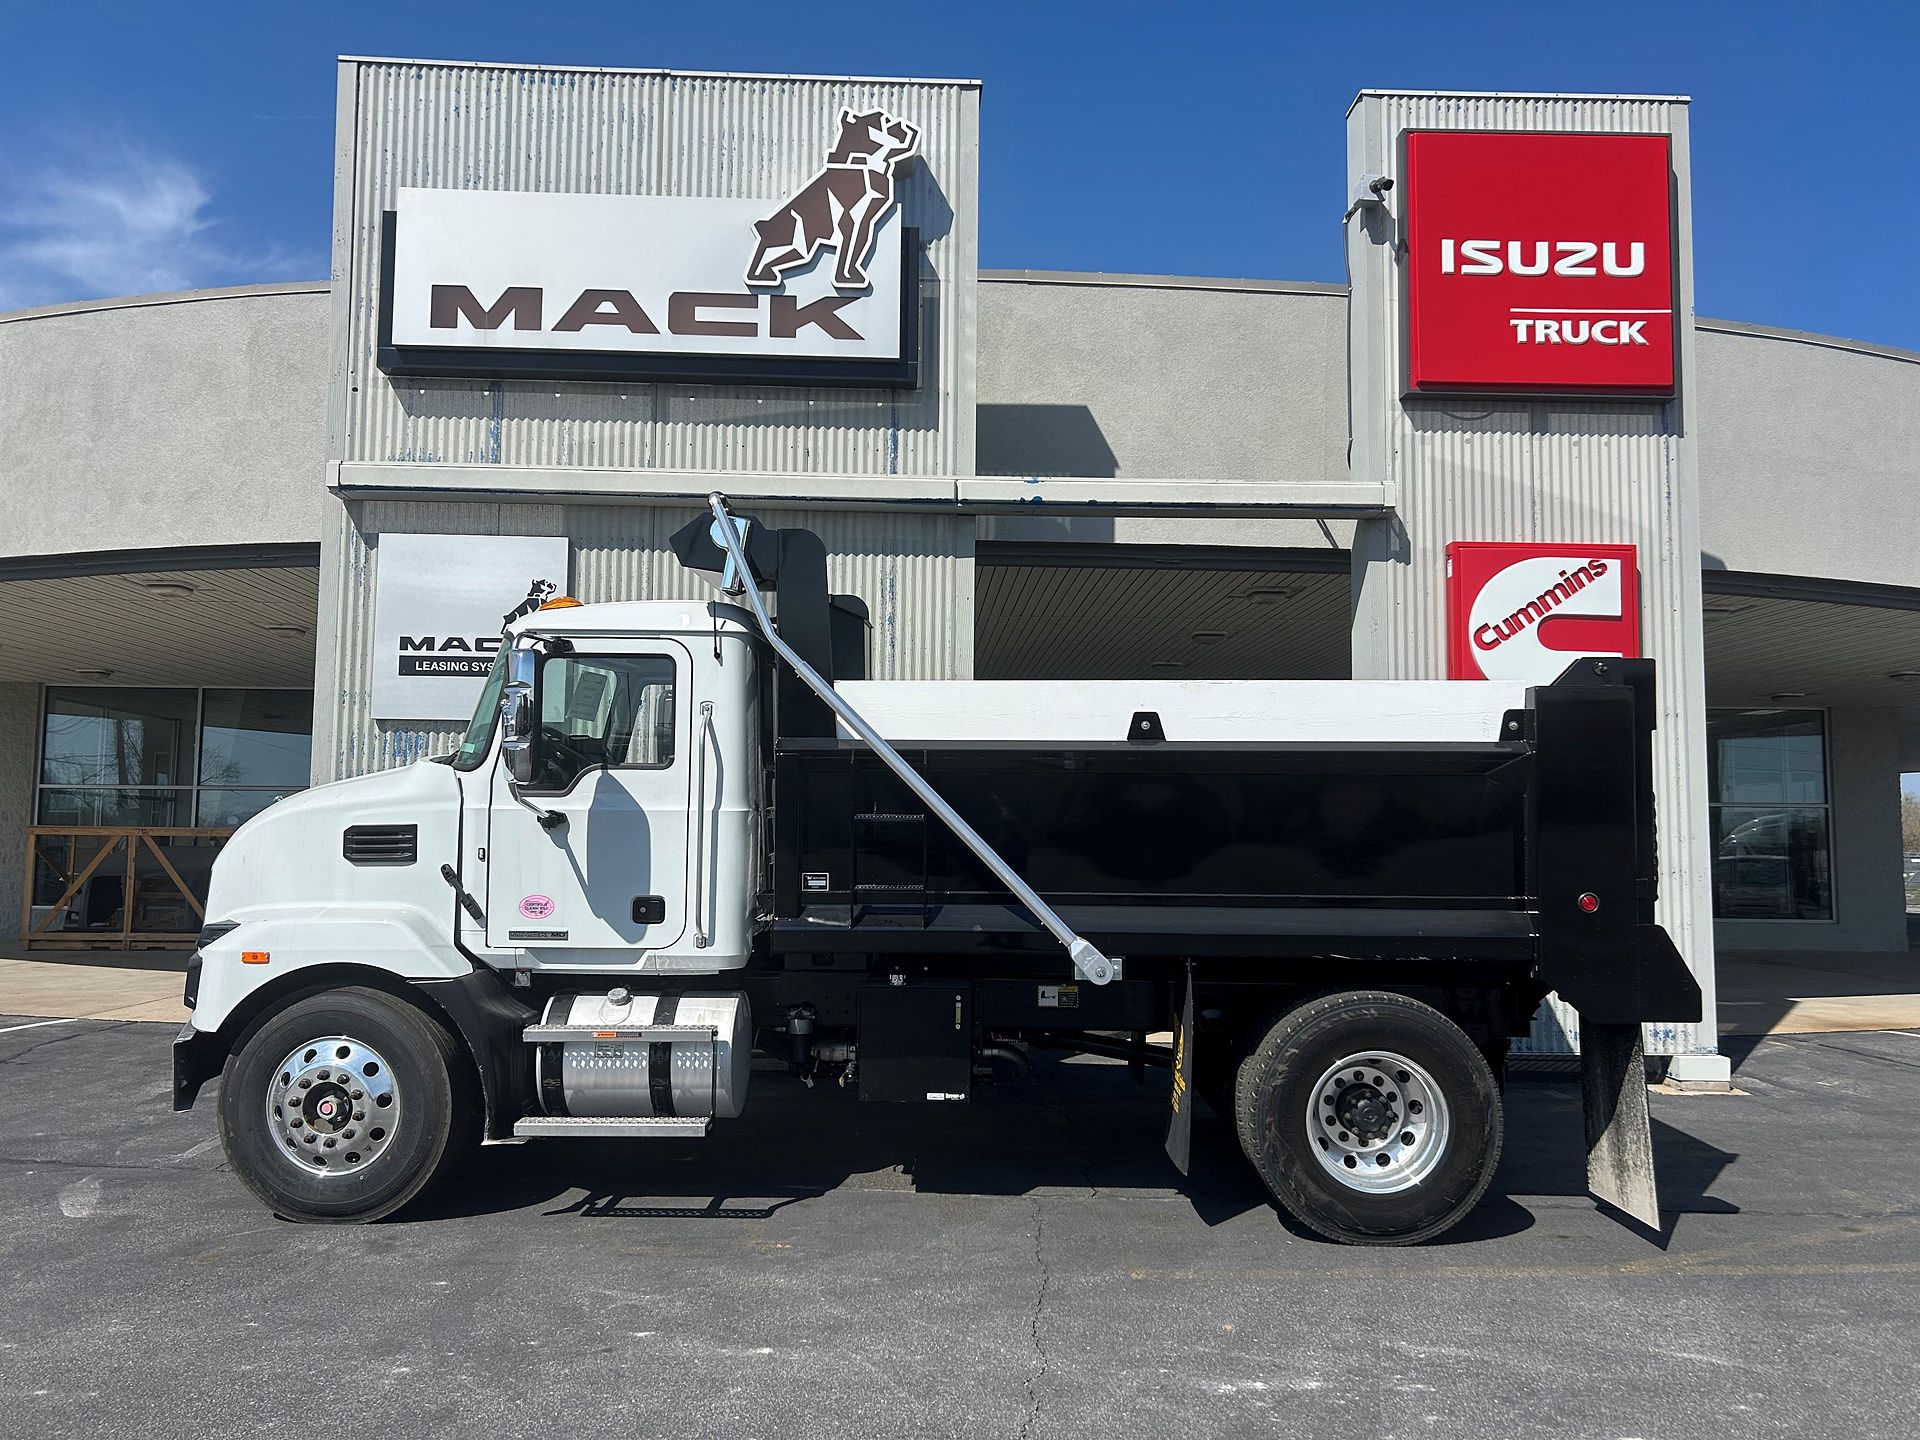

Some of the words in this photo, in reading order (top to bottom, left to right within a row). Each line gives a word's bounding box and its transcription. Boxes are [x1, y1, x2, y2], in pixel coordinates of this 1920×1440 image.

[1441, 238, 1645, 277] ISUZU
[430, 284, 865, 341] MACK
[1509, 318, 1650, 345] TRUCK
[1473, 559, 1608, 651] Cummins
[399, 636, 504, 652] MAC
[415, 660, 469, 672] LEASING
[471, 661, 494, 672] SYS
